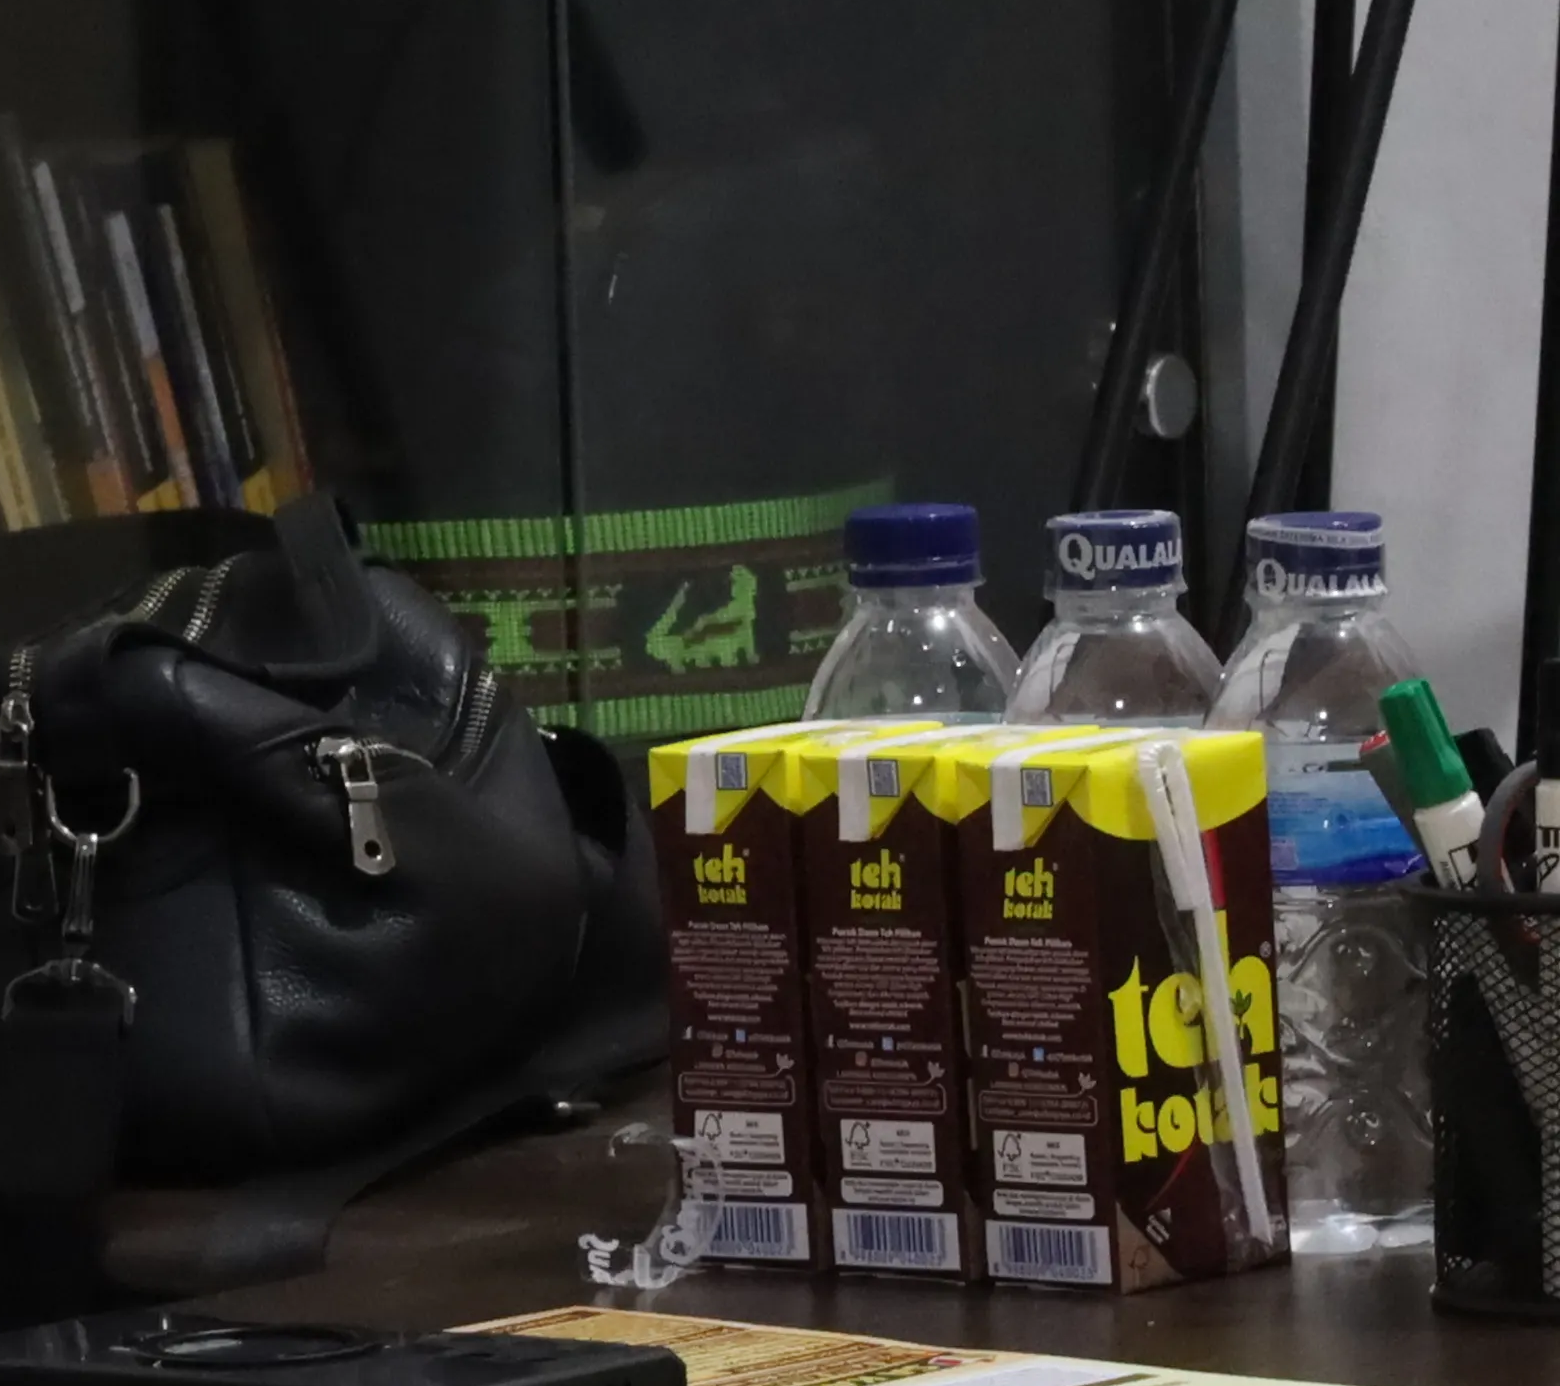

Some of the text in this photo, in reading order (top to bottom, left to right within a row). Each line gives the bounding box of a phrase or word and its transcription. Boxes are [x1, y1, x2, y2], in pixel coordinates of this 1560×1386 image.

[693, 843, 746, 884] teh
[849, 848, 902, 889] teh
[1004, 857, 1055, 898] teh
[698, 884, 748, 904] kotak
[850, 889, 902, 910] kotak
[1003, 898, 1053, 919] kotak
[1107, 908, 1276, 1078] teh
